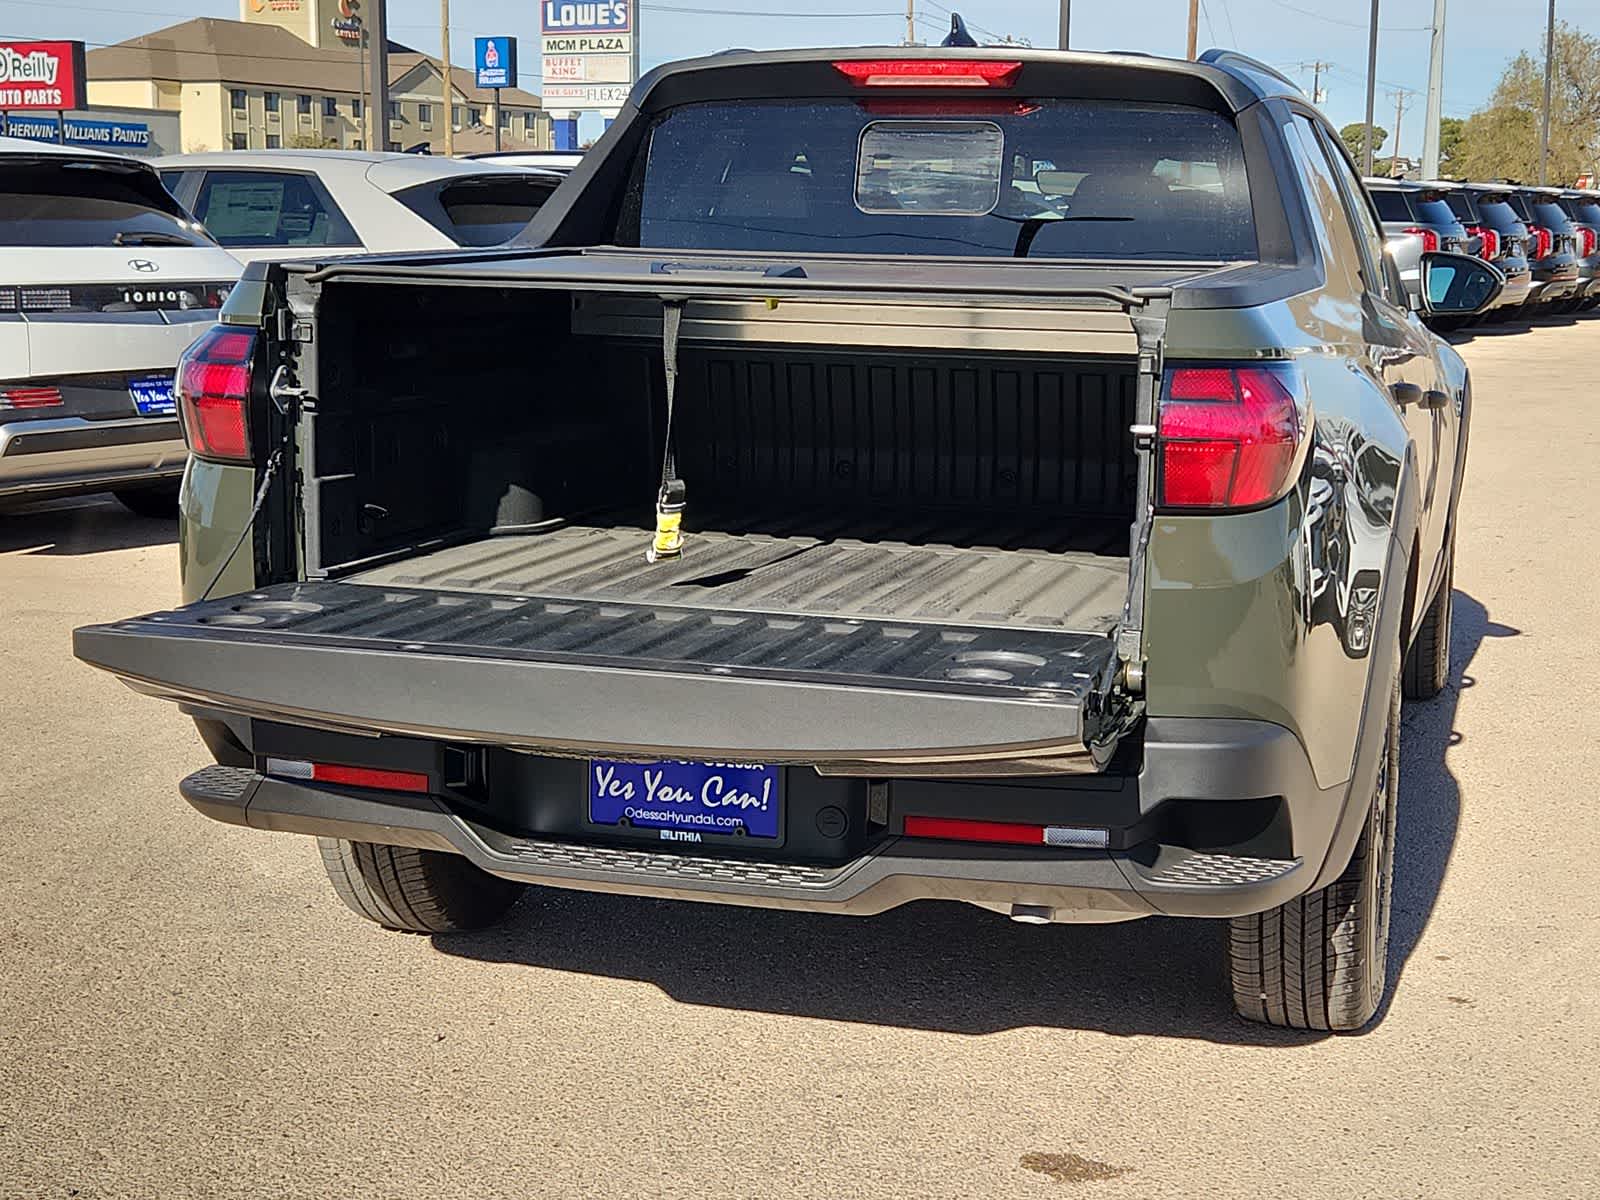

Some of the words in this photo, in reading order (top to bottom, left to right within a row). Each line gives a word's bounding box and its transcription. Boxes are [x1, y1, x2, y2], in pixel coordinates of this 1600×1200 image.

[547, 0, 626, 26] LOWE'S
[546, 40, 576, 51] MCM
[580, 39, 624, 50] PLAZA
[545, 58, 582, 67] BUFFET
[551, 67, 577, 76] KING
[23, 89, 62, 105] PARTS
[112, 127, 149, 144] PAINTS
[124, 291, 177, 303] IONIQ
[595, 766, 636, 800] Yes
[644, 770, 694, 803] You
[701, 776, 772, 811] Can!
[670, 830, 702, 843] LITHIA
